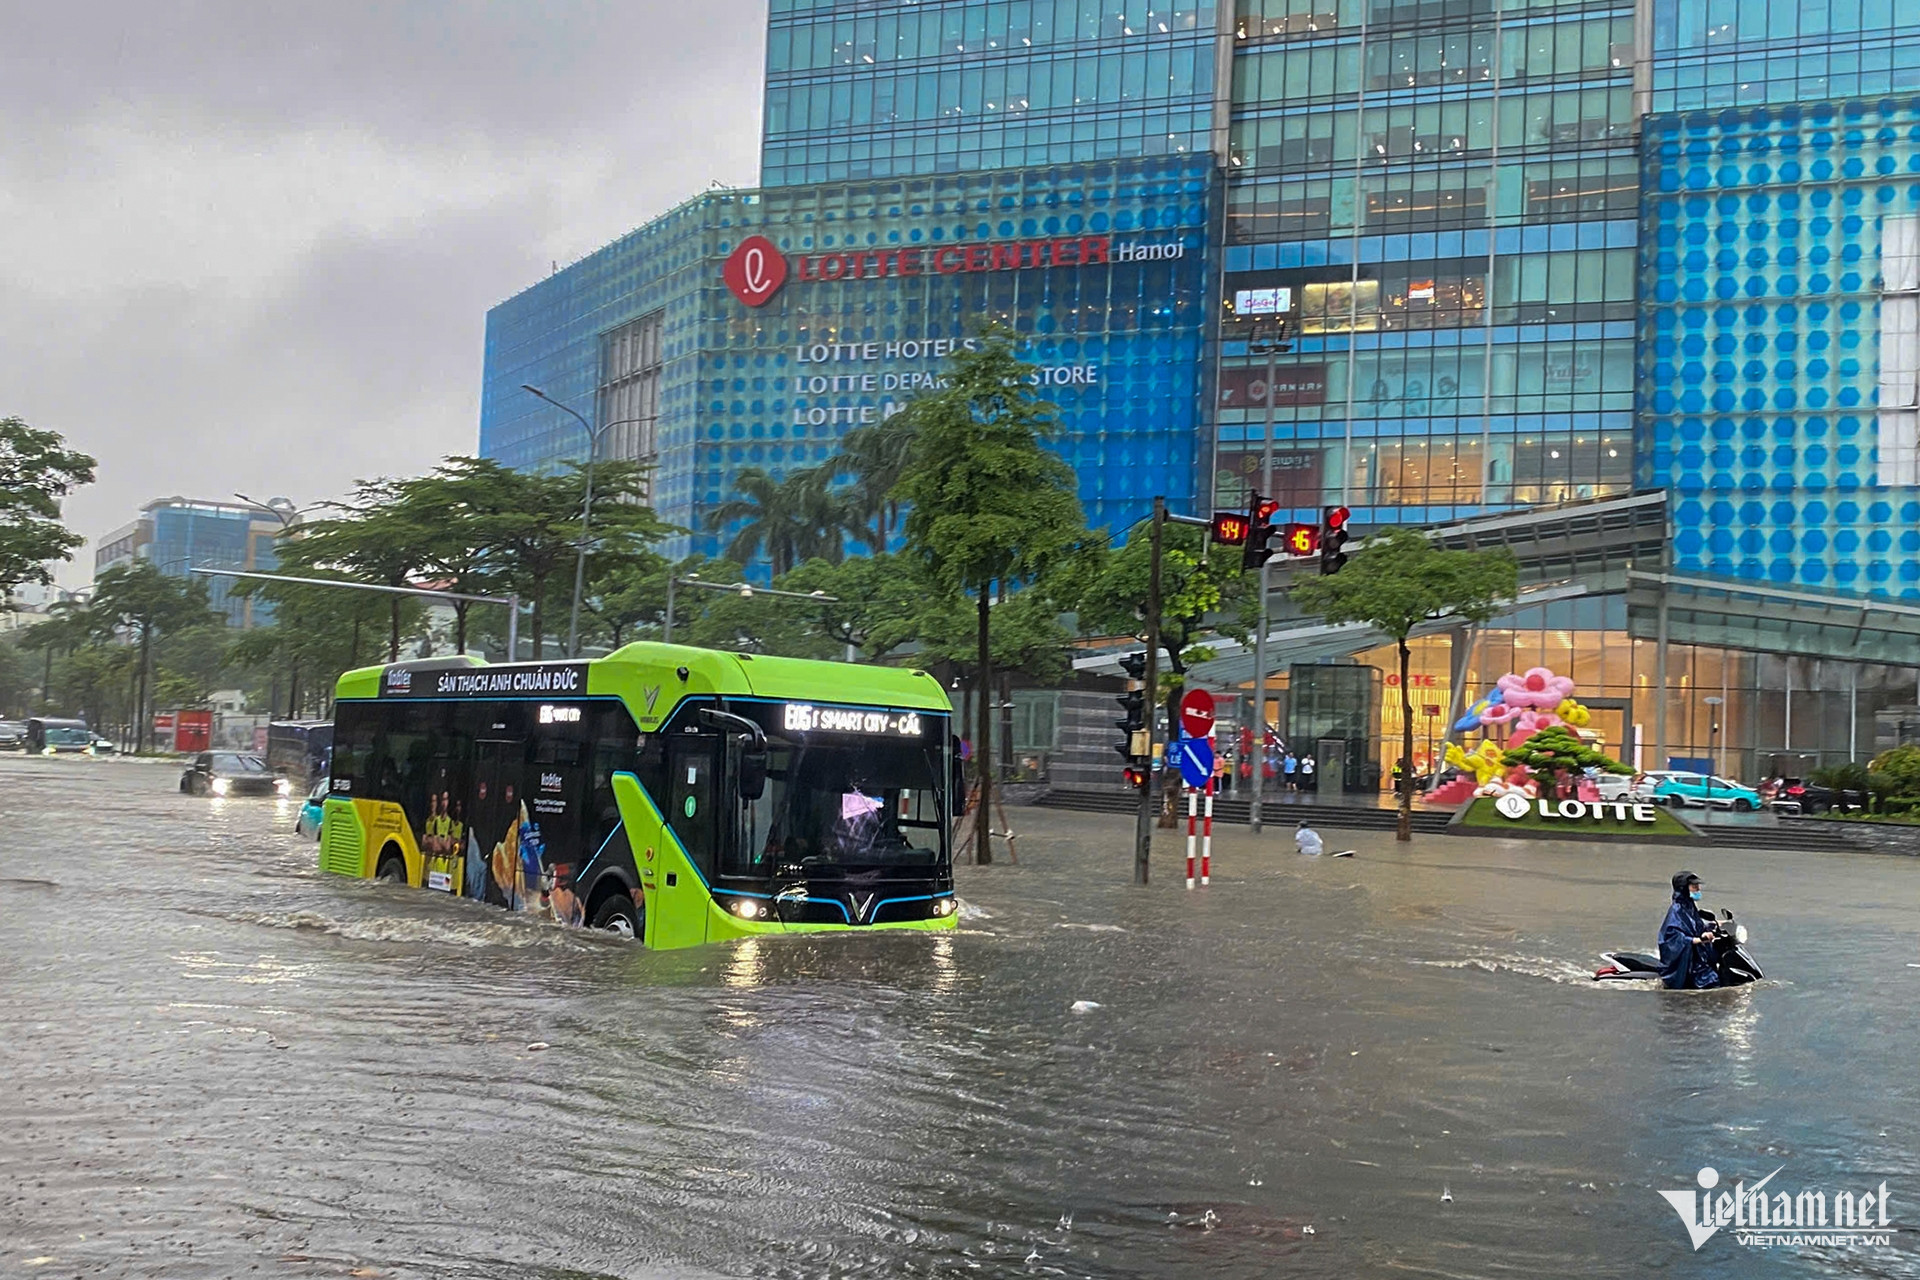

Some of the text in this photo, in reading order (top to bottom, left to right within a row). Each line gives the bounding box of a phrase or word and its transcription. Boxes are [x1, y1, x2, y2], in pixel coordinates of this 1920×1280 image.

[798, 237, 1184, 281] LOTTE CENTER Hanoi
[797, 343, 879, 363] LOTTE
[796, 374, 877, 394] LOTTE
[1029, 365, 1098, 386] STORE
[794, 406, 876, 425] LOTTE
[1221, 521, 1240, 540] 44
[437, 666, 578, 695] SÀN THẠCH ANH CHUẨN ĐỨC
[1383, 674, 1437, 687] OTE
[820, 710, 864, 731] SMART
[864, 713, 889, 732] CITY
[1538, 798, 1657, 822] LOTTE
